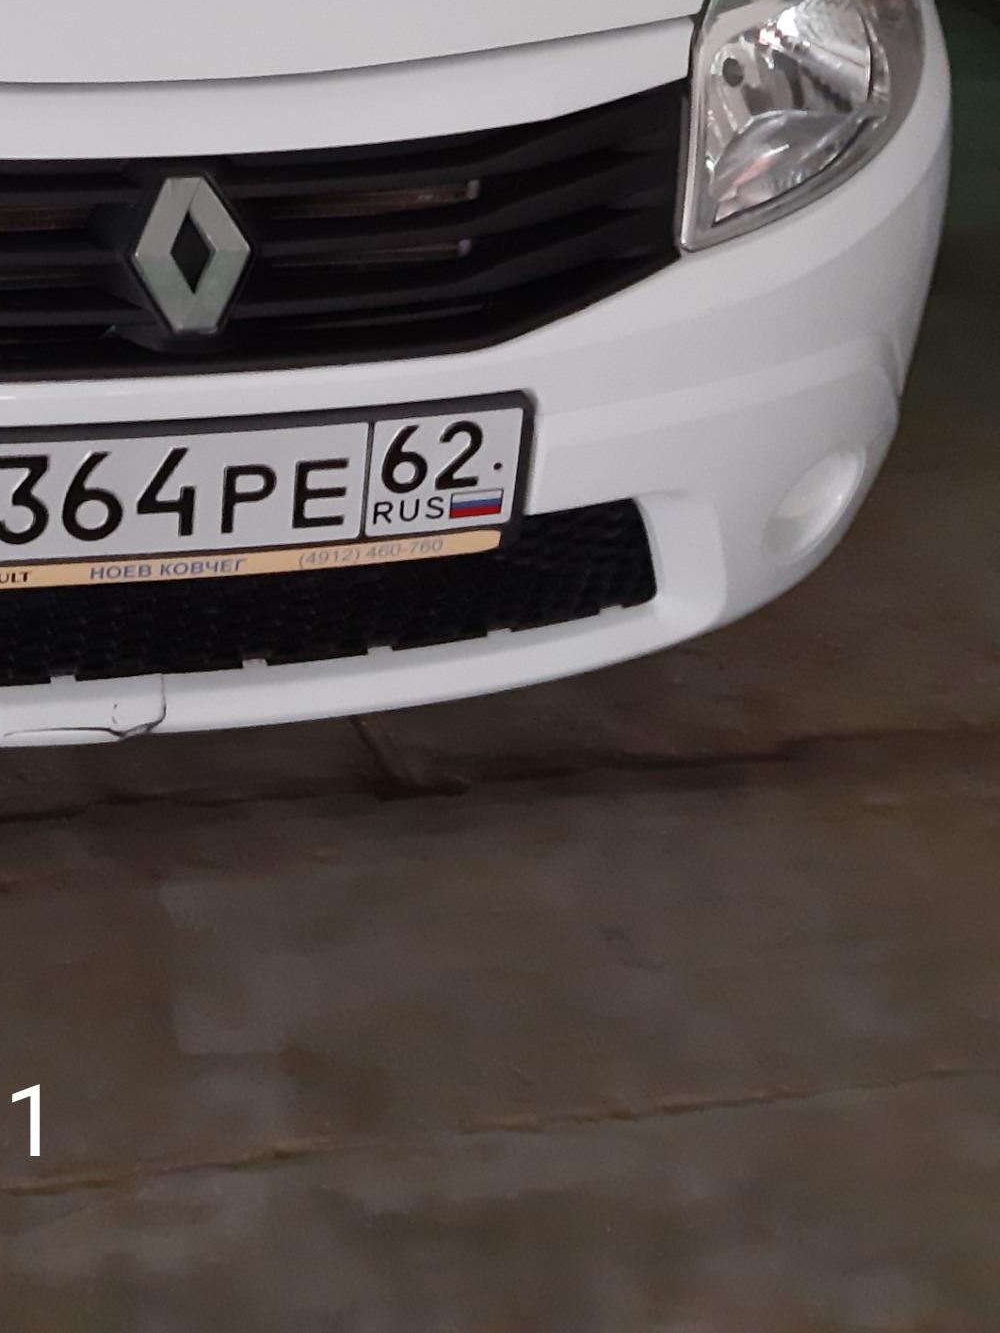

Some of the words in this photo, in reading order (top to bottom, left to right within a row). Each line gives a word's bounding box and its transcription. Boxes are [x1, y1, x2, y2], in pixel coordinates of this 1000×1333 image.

[381, 421, 483, 494] 62
[372, 496, 444, 525] RUS
[298, 549, 360, 568] (4912)
[365, 539, 444, 560] 460-760
[90, 562, 151, 580] НОЕВ
[160, 558, 247, 576] КОВЧЕГ
